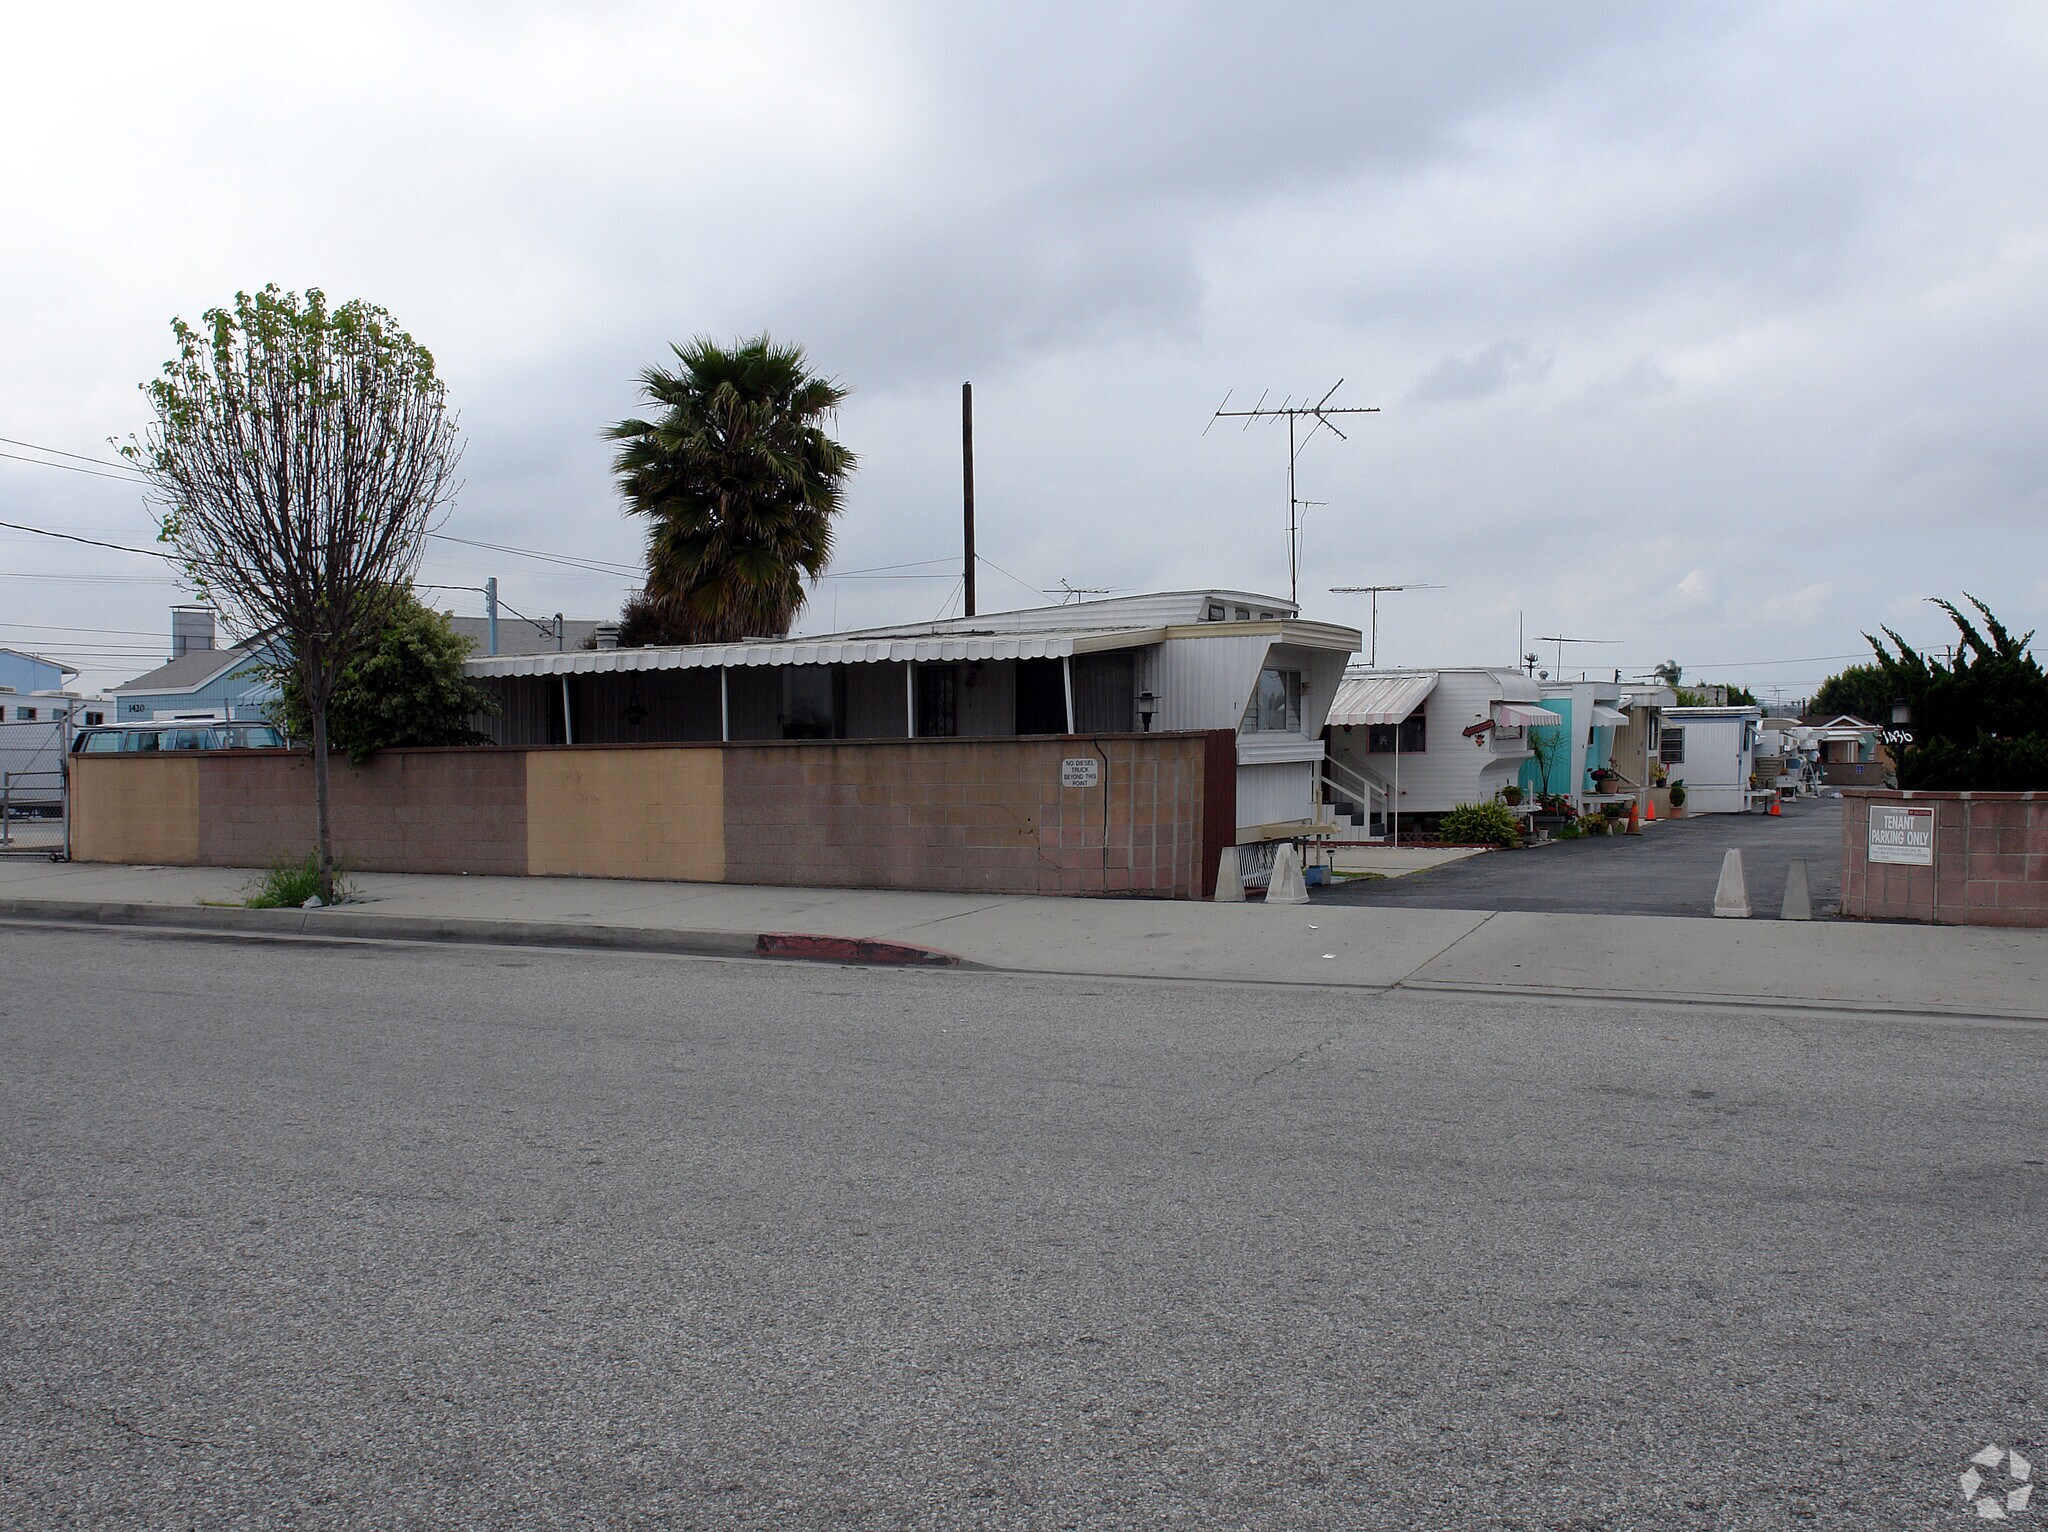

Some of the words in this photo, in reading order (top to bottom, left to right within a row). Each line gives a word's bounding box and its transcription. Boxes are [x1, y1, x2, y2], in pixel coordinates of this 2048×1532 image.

[128, 704, 145, 713] 1420
[1882, 730, 1913, 744] 1436
[1883, 815, 1915, 830] TENANT
[1871, 829, 1905, 845] PARKING
[1906, 831, 1929, 846] ONLY
